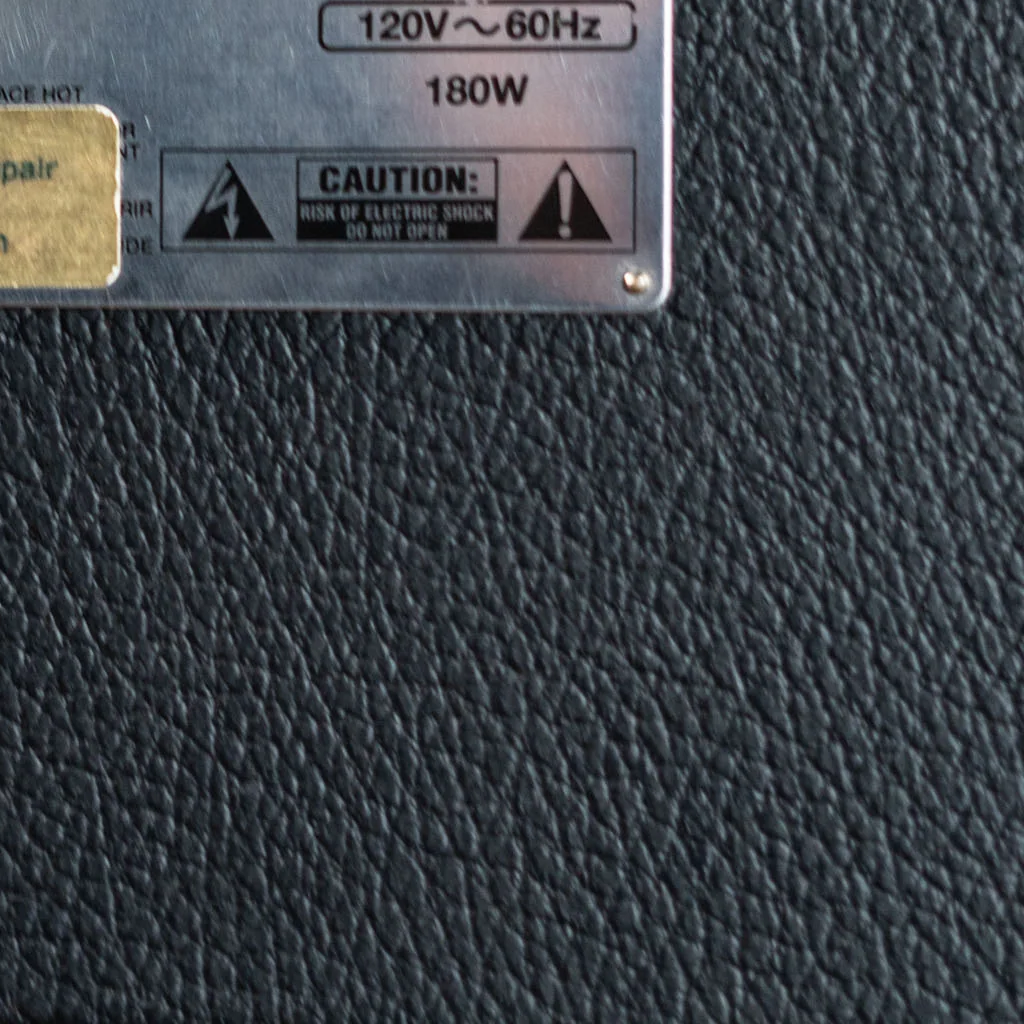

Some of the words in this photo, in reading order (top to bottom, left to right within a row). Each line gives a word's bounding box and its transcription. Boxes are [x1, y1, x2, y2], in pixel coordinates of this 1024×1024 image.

[42, 83, 84, 103] HOT
[425, 74, 529, 106] 180W
[318, 164, 479, 194] CAUTION:
[299, 202, 337, 222] RISK
[341, 202, 360, 221] OF
[364, 202, 439, 222] ELECTRIC
[442, 202, 495, 222] SHOCK
[346, 223, 368, 241] DO
[371, 223, 402, 241] NOT
[406, 223, 448, 241] OPEN
